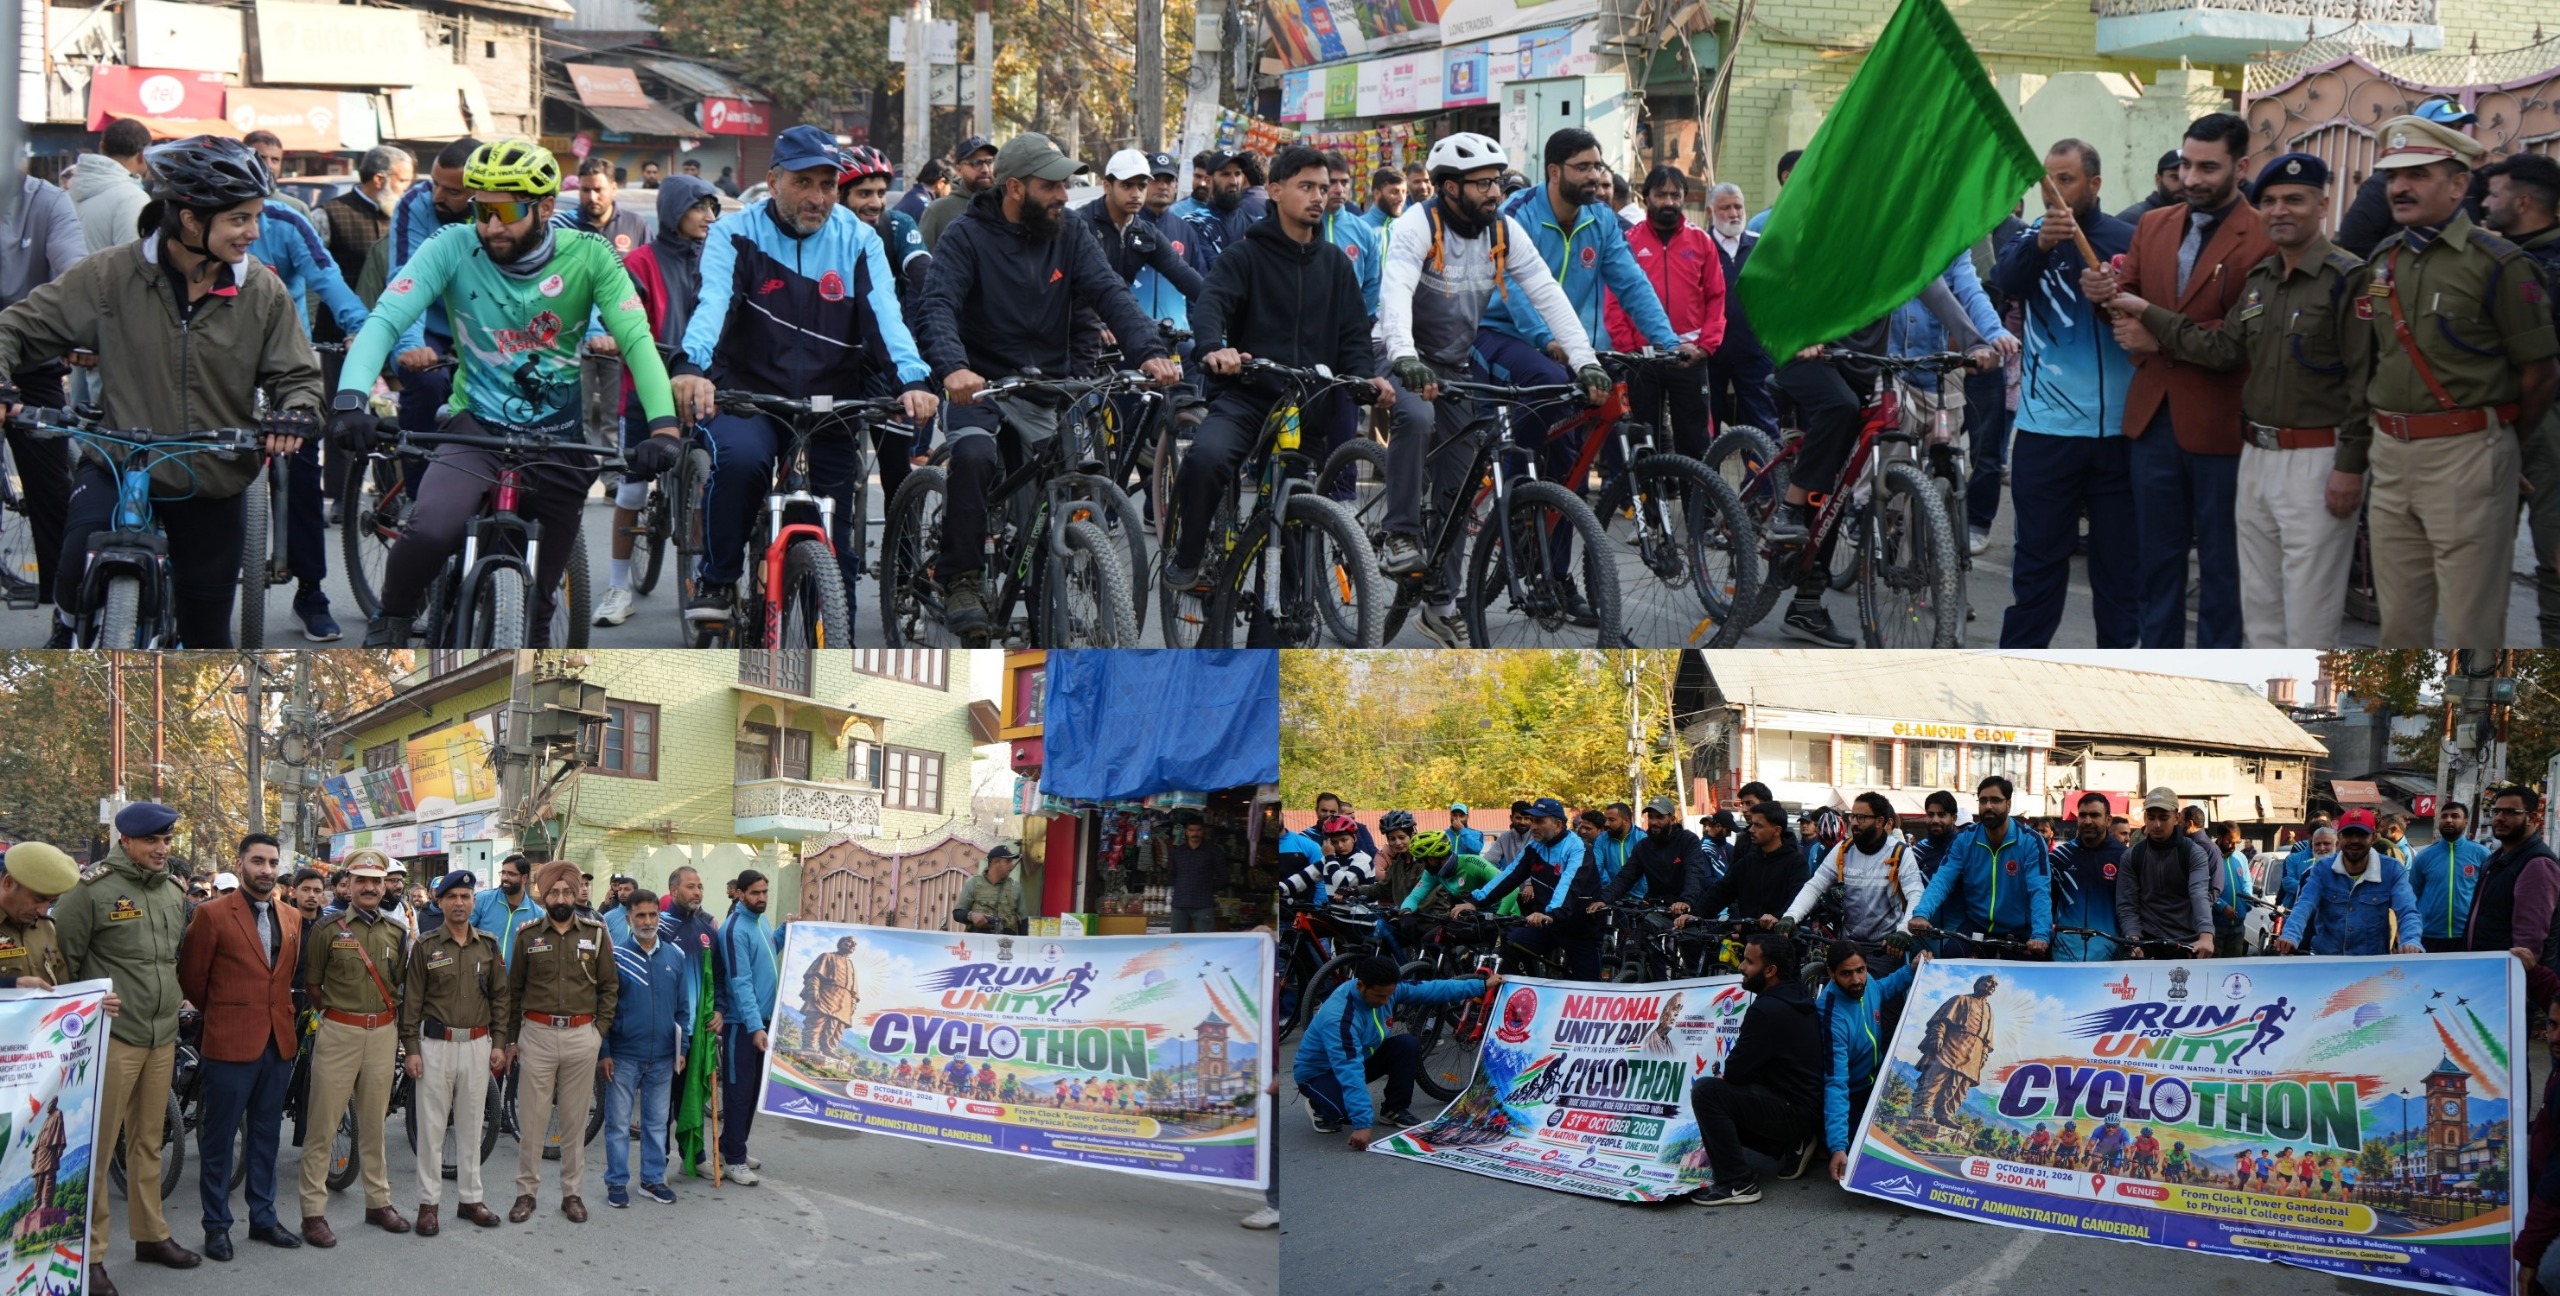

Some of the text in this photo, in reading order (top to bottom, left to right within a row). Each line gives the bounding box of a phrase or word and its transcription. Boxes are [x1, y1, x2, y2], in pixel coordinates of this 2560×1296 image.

[1448, 16, 1493, 36] LONE TRADERS
[1892, 722, 2016, 742] GLAMOUR GLOW
[951, 963, 1055, 987] RUN
[2112, 987, 2137, 995] UNITY
[941, 989, 1063, 1015] UNITY
[1561, 994, 1660, 1021] NATIONAL
[2110, 1002, 2242, 1031] RUN
[1555, 1020, 1655, 1045] UNITY DAY
[1721, 1026, 1741, 1034] DIVERSIT
[2139, 1029, 2173, 1037] FOR
[36, 1050, 54, 1059] PATEL
[869, 1012, 1150, 1081] CYCLOTHON
[2093, 1034, 2250, 1064] UNITY
[60, 1053, 68, 1062] IN
[2086, 1058, 2121, 1066] STRONGER
[2124, 1060, 2159, 1069] TOGETHER
[1561, 1058, 1687, 1102] CYCLOTHON
[873, 1085, 903, 1096] OCTOBER
[916, 1093, 933, 1101] 2026
[873, 1093, 913, 1106] 9:00 AM
[826, 1100, 851, 1109] Organised
[973, 1106, 999, 1114] VENUE:
[1569, 1098, 1579, 1106] RIDE
[1579, 1099, 1588, 1107] FOR
[1603, 1101, 1614, 1109] RIDE
[1614, 1102, 1623, 1110] FOR
[1650, 1105, 1664, 1114] INDIA
[1998, 1063, 2362, 1153] CYCLOTHON
[825, 1107, 994, 1144] DISTRICT ADMINISTRATION GANDERBAL
[1014, 1107, 1140, 1126] From Clock Tower Ganderbal
[1019, 1115, 1137, 1135] to Physical College Gadoora
[1588, 1117, 1630, 1134] OCTOBER
[1631, 1121, 1659, 1137] 2026
[1538, 1128, 1552, 1137] ONE
[1581, 1135, 1594, 1144] ONE
[1595, 1136, 1623, 1150] PEOPLE,
[1625, 1141, 1640, 1151] ONE
[1641, 1143, 1660, 1153] INDIA
[1432, 1151, 1476, 1166] DISTRICT
[1477, 1161, 1561, 1184] ADMINISTRATION
[1562, 1178, 1625, 1197] GANDERBAL
[1995, 1172, 2046, 1189] 9:00 AM
[1996, 1163, 2073, 1181] OCTOBER 31, 2026
[1932, 1180, 1977, 1195] Organised by:
[2126, 1186, 2159, 1197] VENUE:
[2180, 1188, 2349, 1216] From Clock Tower Ganderbal
[1929, 1189, 2151, 1239] DISTRICT ADMINISTRATION GANDERBAL
[2186, 1200, 2344, 1228] to Physical College Gadoora
[2219, 1223, 2266, 1235] Department
[2267, 1229, 2276, 1237] of
[2277, 1231, 2326, 1244] Information
[2336, 1237, 2362, 1246] Public
[2364, 1240, 2406, 1252] Relations,
[2409, 1246, 2427, 1254] J&K
[2243, 1238, 2396, 1260] Courtesy: District Information Centre, Ganderbal
